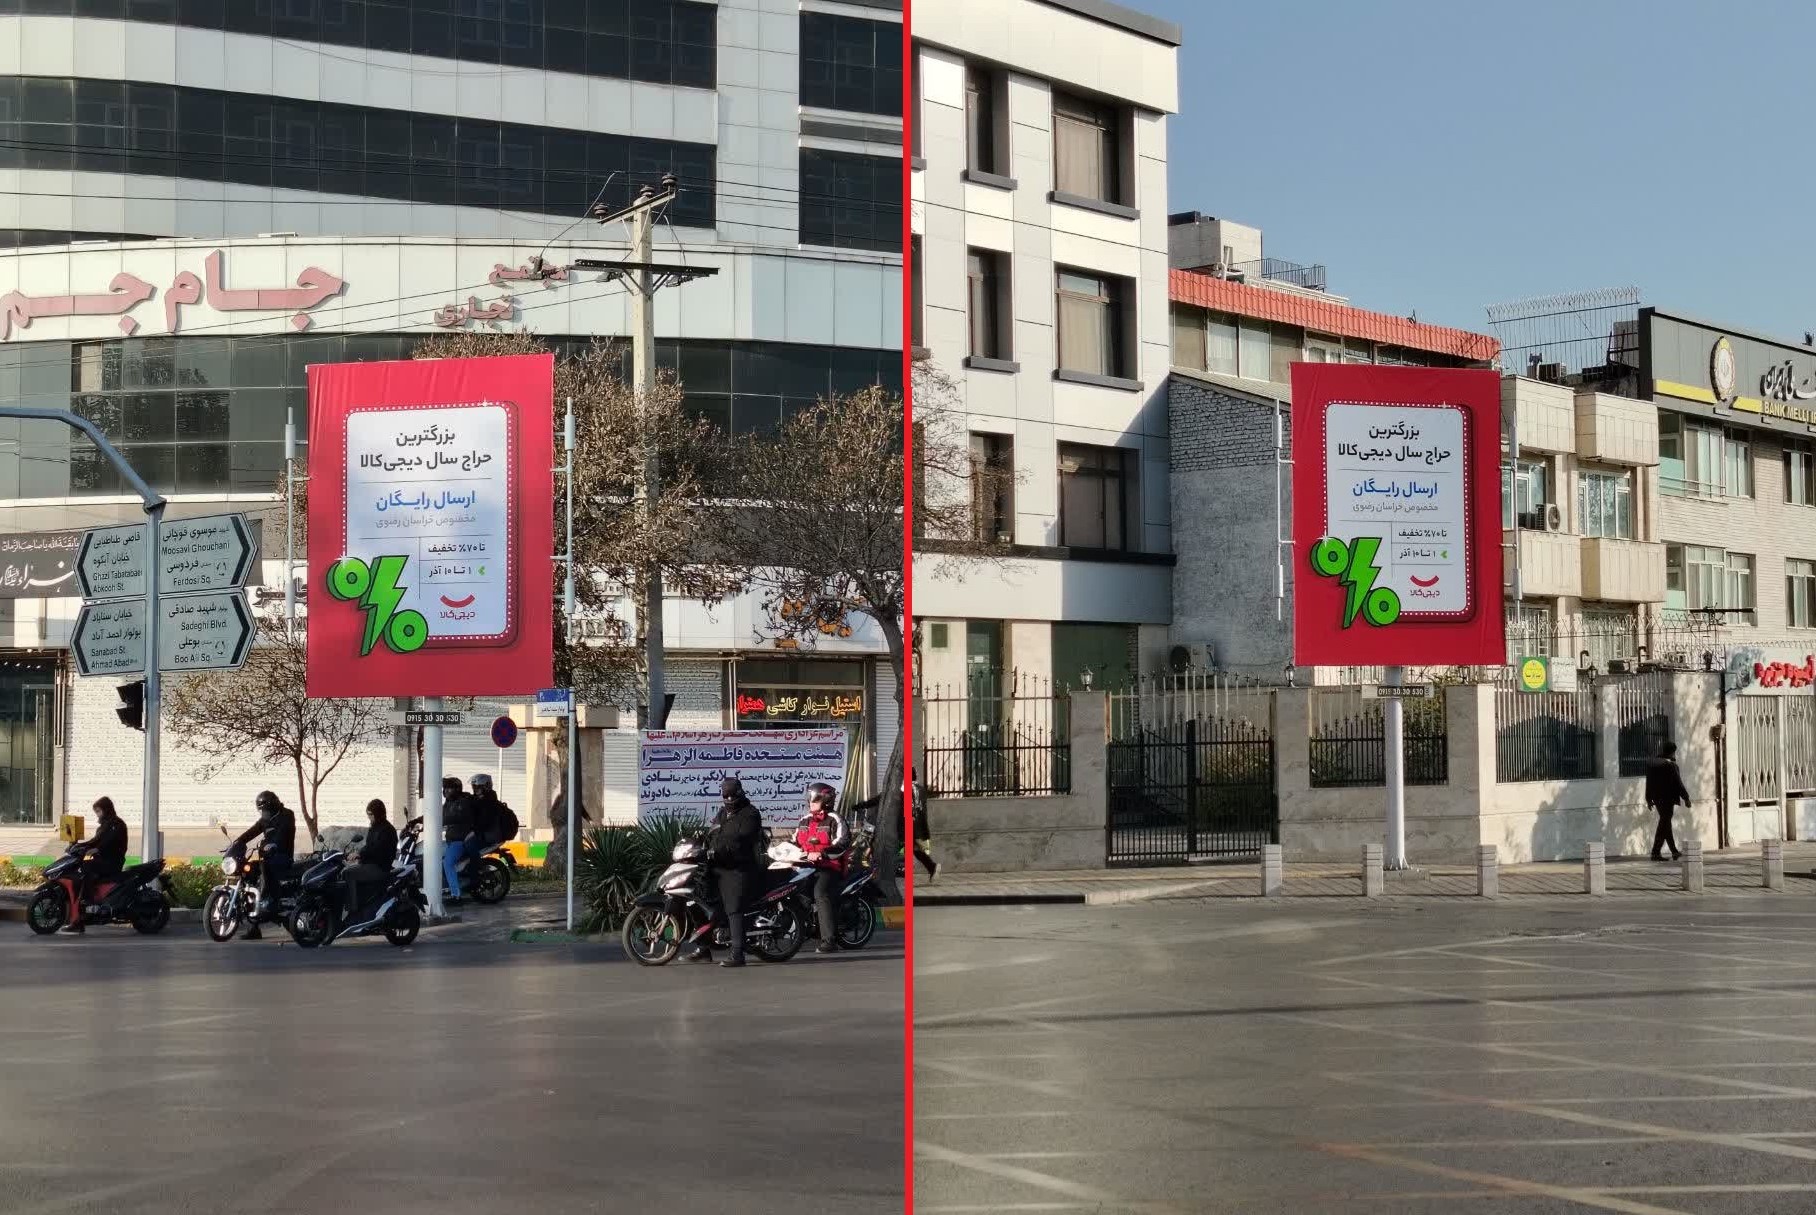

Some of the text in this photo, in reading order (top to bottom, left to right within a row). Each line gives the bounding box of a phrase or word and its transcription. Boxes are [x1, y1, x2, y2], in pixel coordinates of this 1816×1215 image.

[0, 249, 344, 340] جام جم
[434, 295, 514, 329] تجاری
[1764, 402, 1784, 418] BANK
[1786, 406, 1809, 423] MELLI
[396, 424, 456, 446] بزرگترین
[1369, 420, 1420, 440] بزرگترین
[426, 451, 458, 470] سال
[461, 450, 492, 471] حراج
[1395, 445, 1423, 462] سال
[1425, 446, 1451, 465] حراج
[1353, 478, 1438, 499] ارسال رایگان
[376, 490, 476, 511] ارسال رایگان
[1376, 501, 1403, 513] خراسان
[1405, 502, 1439, 514] مخصوص
[402, 514, 433, 528] خراسان
[189, 527, 217, 539] موسوی
[1398, 529, 1423, 539] تخفیف
[161, 541, 230, 555] Moosavi Ghouchani
[428, 544, 457, 555] تخفیف
[166, 557, 199, 574] فردوسی
[93, 584, 115, 593] Abkooh
[173, 576, 199, 586] Ferdosi
[168, 603, 194, 618] صادقی
[196, 602, 217, 615] شهید
[181, 620, 208, 632] Sadeghi
[178, 636, 200, 650] بوعلی
[174, 654, 188, 664] Boo
[766, 697, 798, 716] کاشی
[830, 695, 861, 717] استیل
[435, 714, 444, 722] 30
[698, 745, 743, 761] فاطمه
[744, 748, 801, 761] متحده
[641, 786, 671, 802] دادوند
